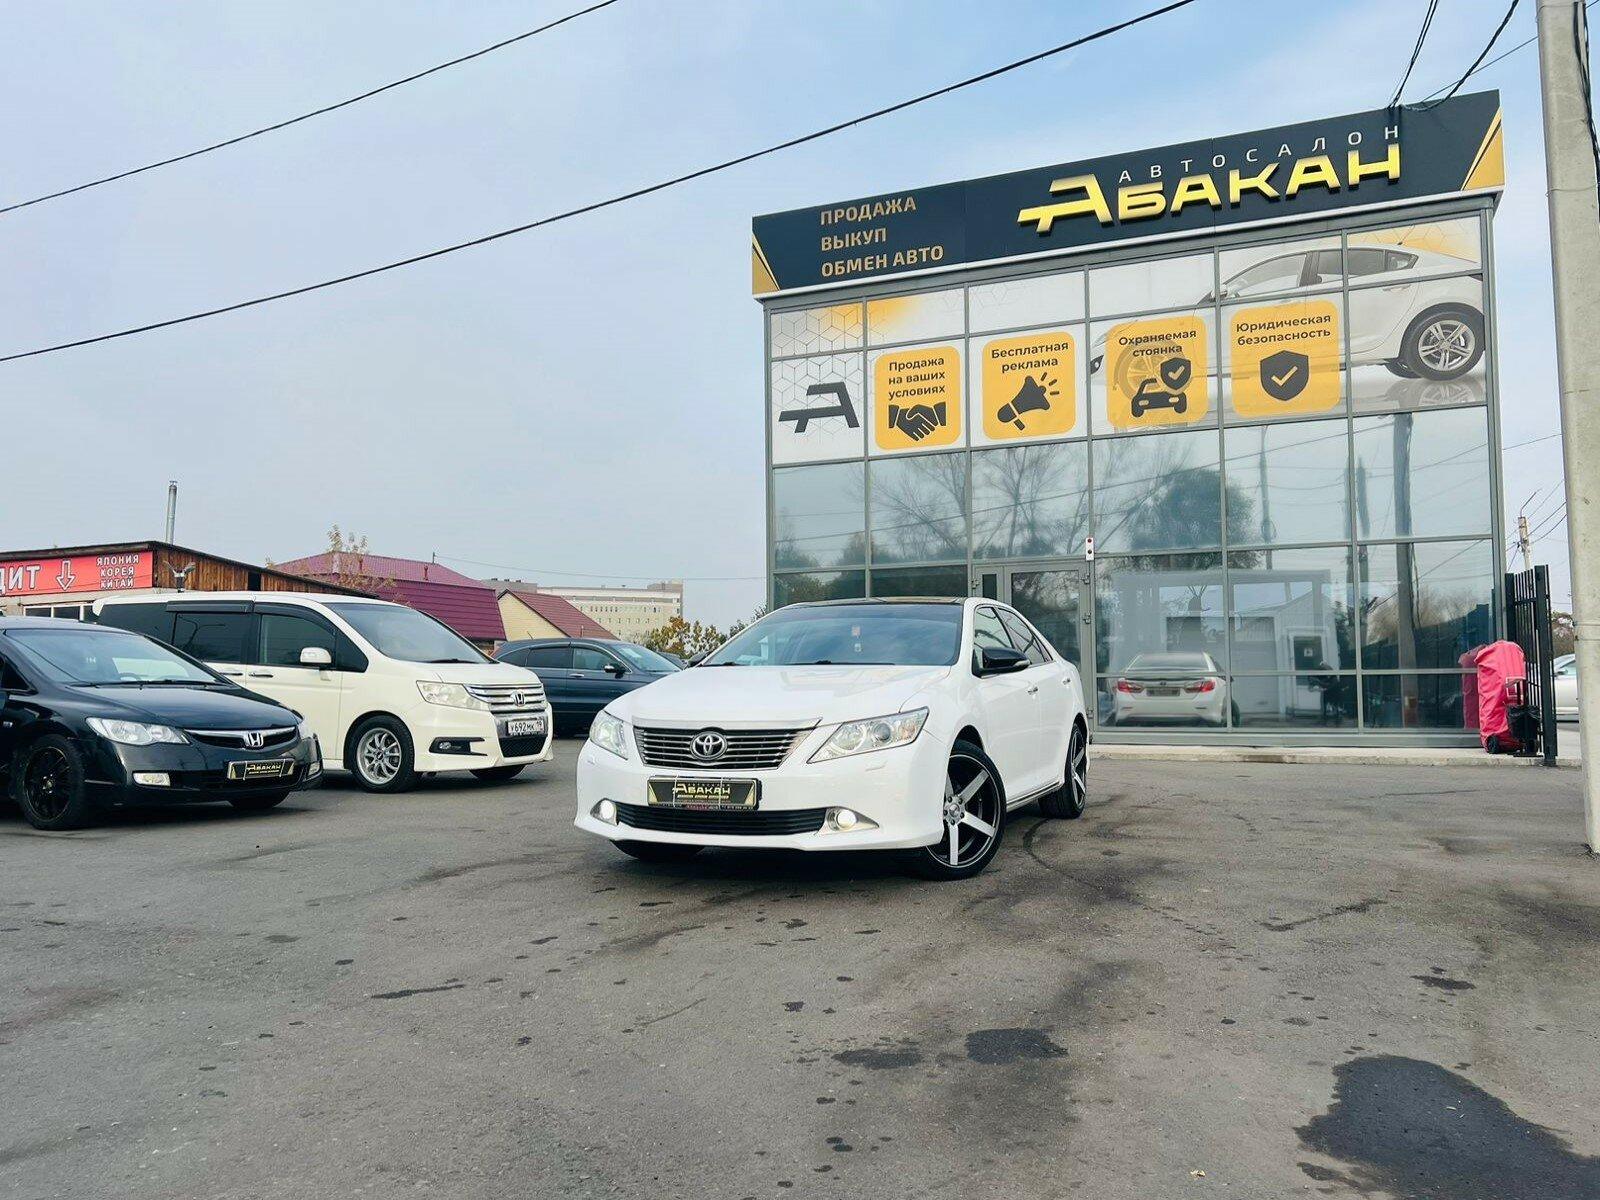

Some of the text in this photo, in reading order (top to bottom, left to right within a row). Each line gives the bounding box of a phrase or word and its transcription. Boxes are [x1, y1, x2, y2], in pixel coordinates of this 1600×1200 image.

[1118, 125, 1399, 184] АВТОСАЛОН
[820, 196, 917, 226] ПРОДАЖА
[821, 227, 888, 252] ВЫКУП
[821, 245, 945, 278] ОБМЕН АВТО
[1236, 314, 1332, 333] Юридическая
[1118, 329, 1197, 347] Охраняемая
[1237, 328, 1332, 347] безопасность
[991, 342, 1069, 359] Бесплатная
[1132, 344, 1183, 358] стоянка
[889, 357, 945, 373] Продажа
[1001, 357, 1059, 374] реклама
[888, 371, 946, 386] на ваших
[888, 384, 946, 402] условиях
[96, 554, 140, 566] ЯПОНИЯ
[100, 566, 135, 577] КОРЕЯ
[100, 576, 134, 589] КИТАЙ
